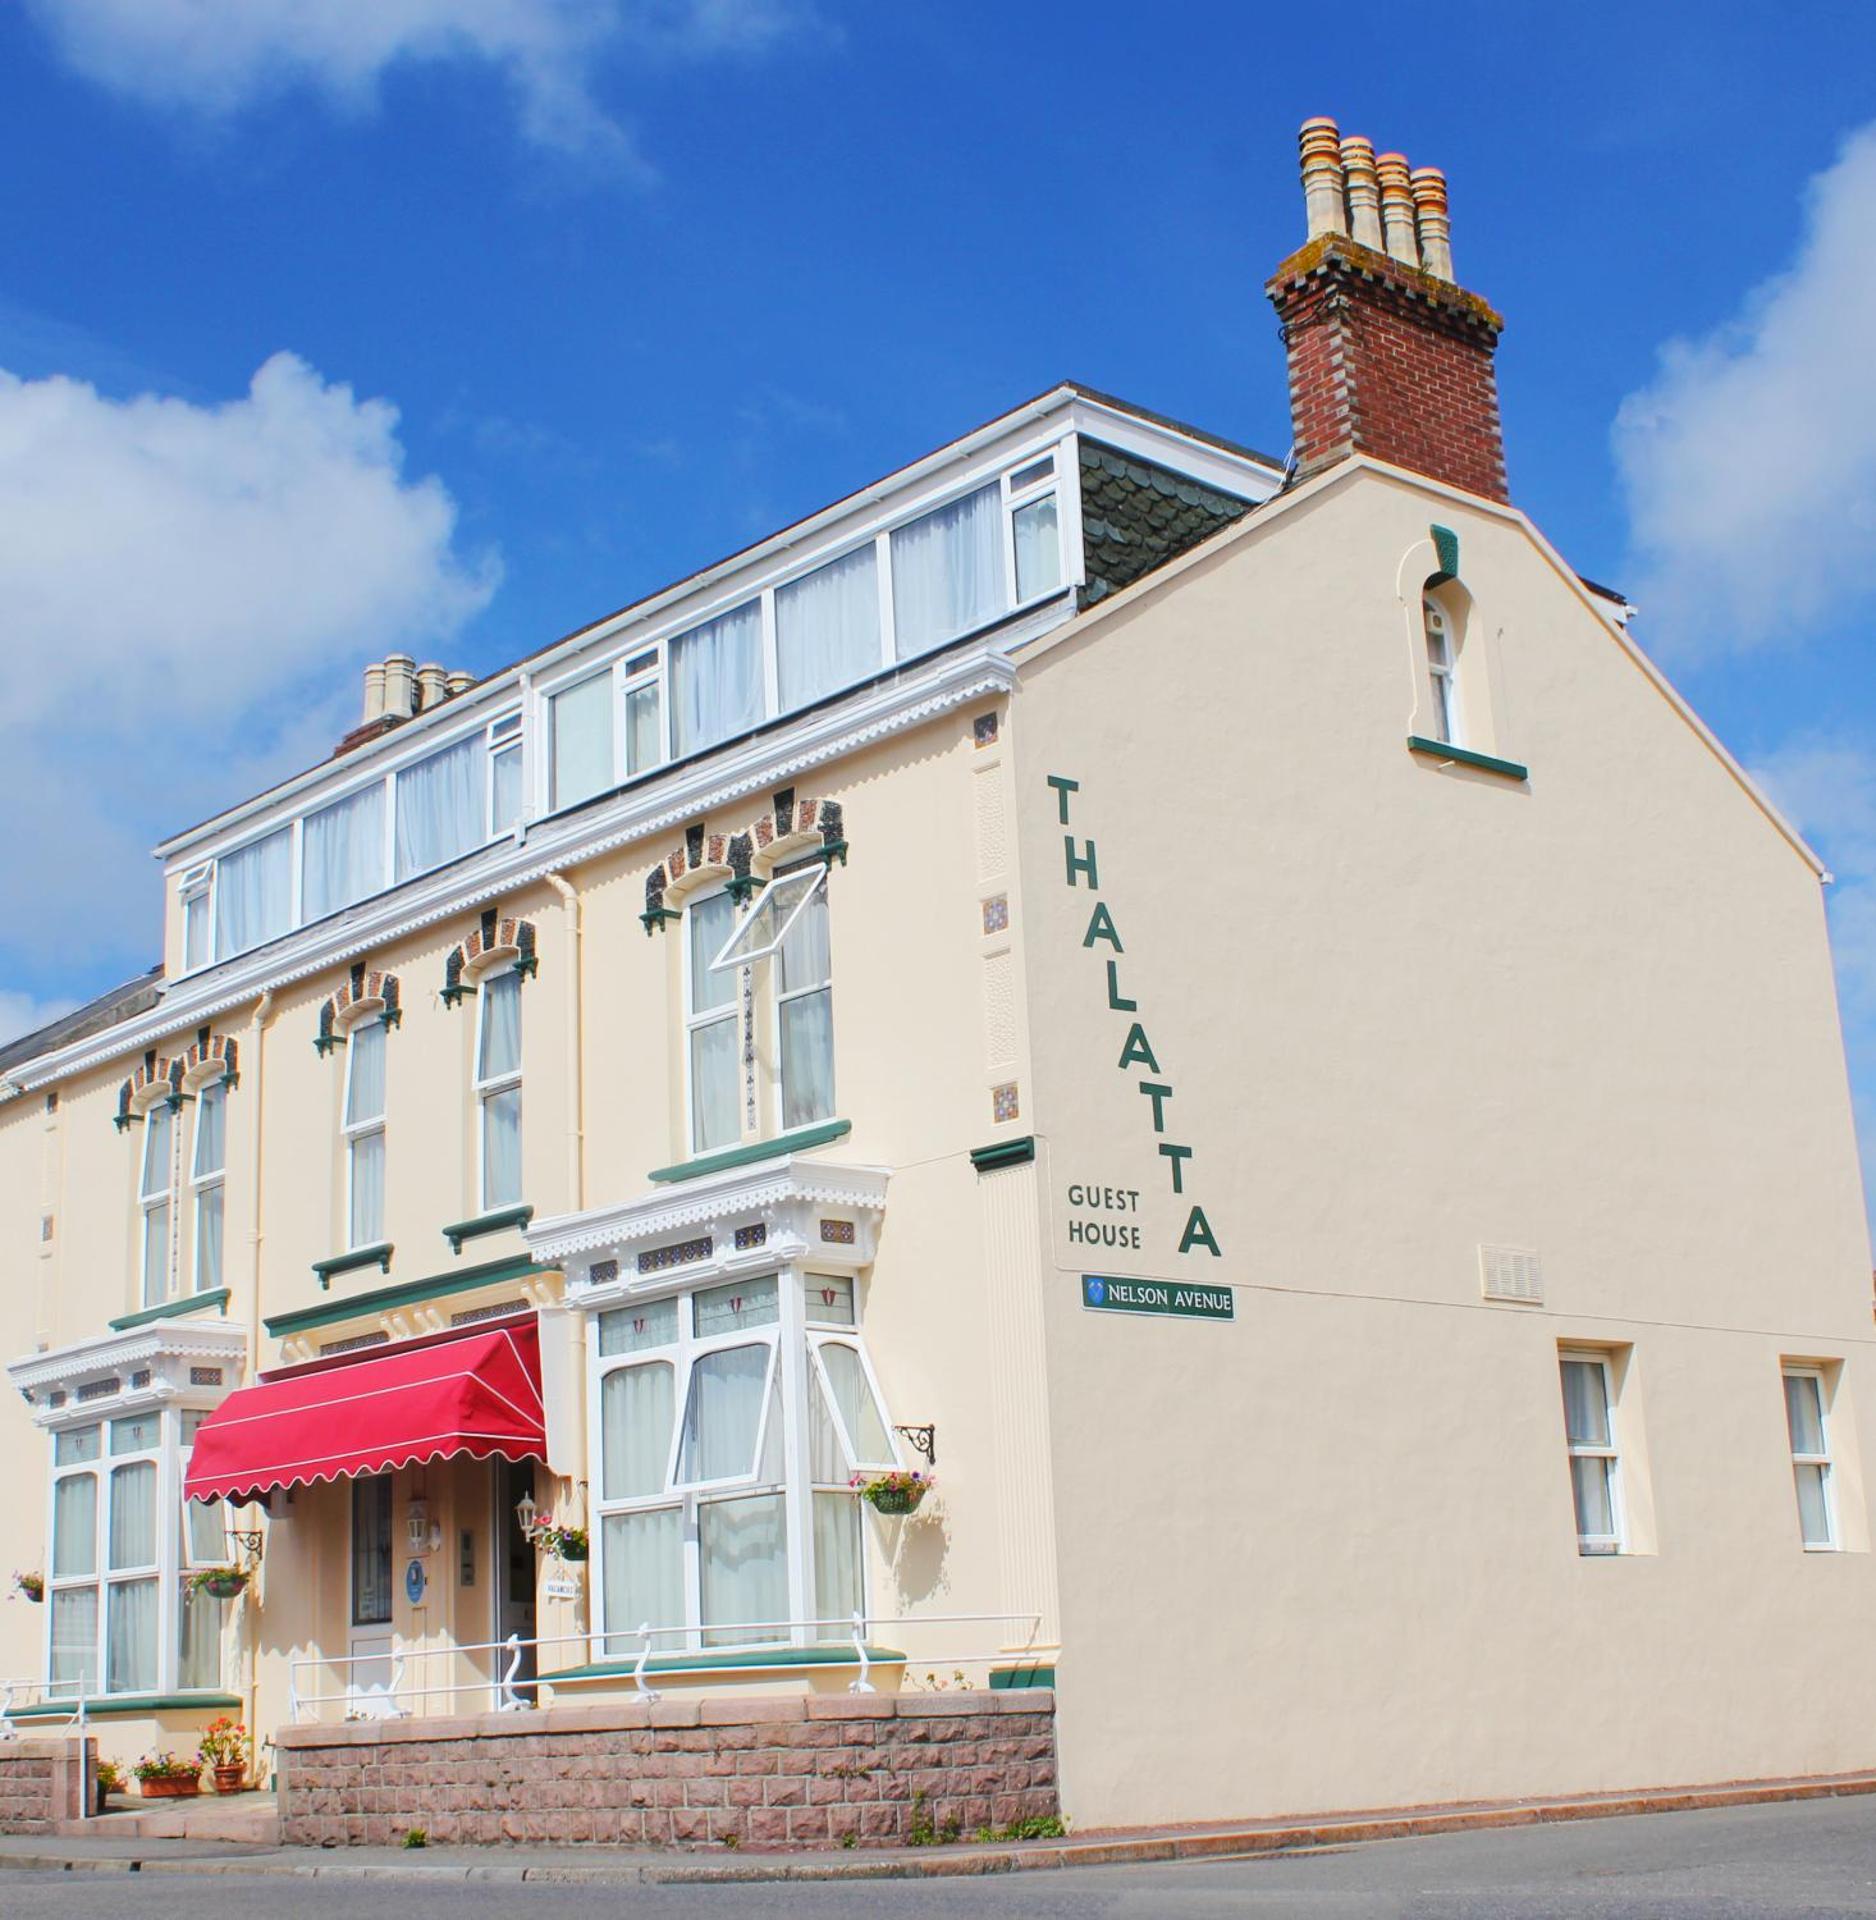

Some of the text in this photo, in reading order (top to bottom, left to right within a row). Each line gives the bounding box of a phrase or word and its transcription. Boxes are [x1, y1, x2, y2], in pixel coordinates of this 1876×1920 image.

[1046, 774, 1222, 1258] THALATTA
[1068, 1184, 1140, 1213] GUEST
[1068, 1219, 1141, 1250] HOUSE
[1108, 1284, 1232, 1311] NELSON AVENUE
